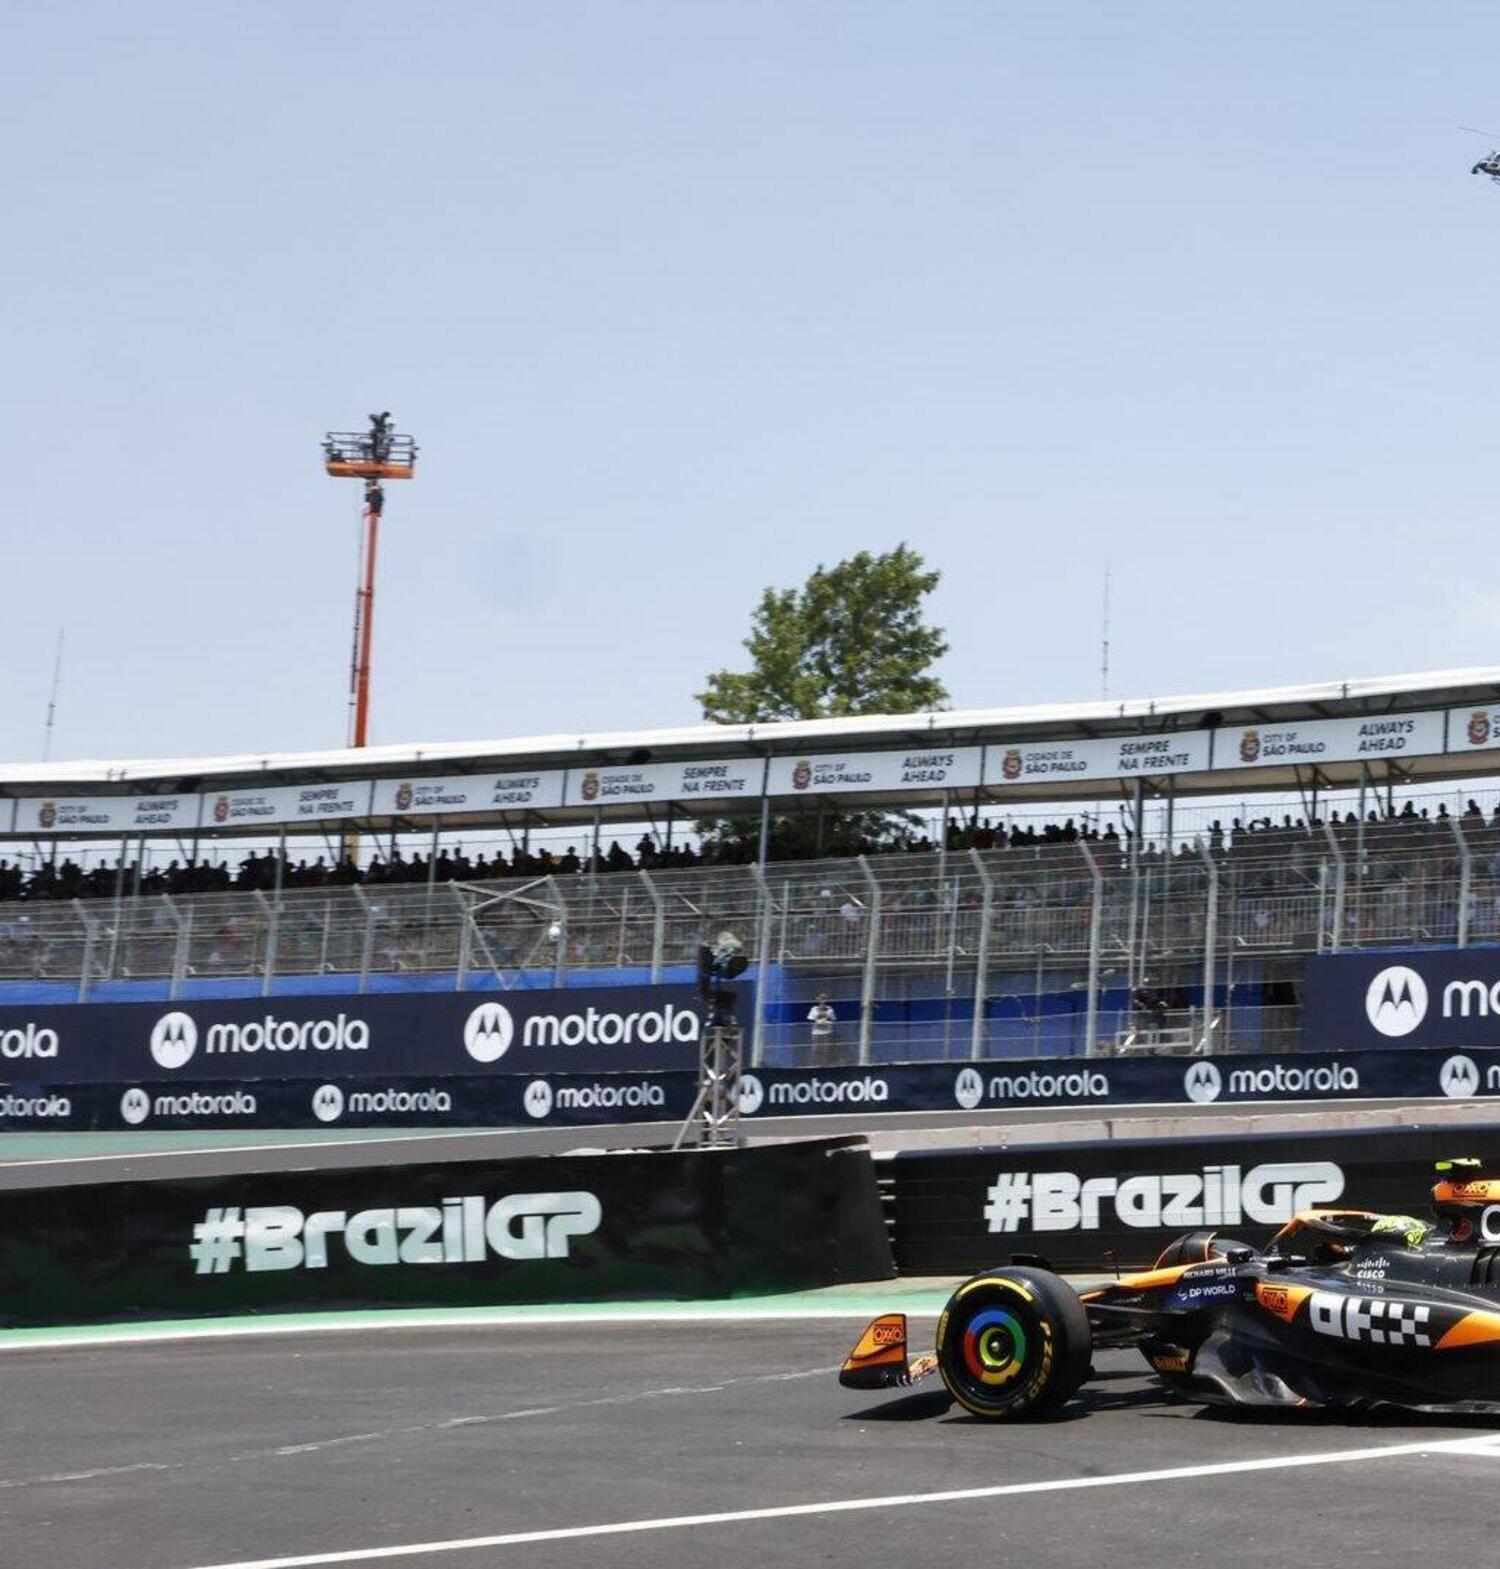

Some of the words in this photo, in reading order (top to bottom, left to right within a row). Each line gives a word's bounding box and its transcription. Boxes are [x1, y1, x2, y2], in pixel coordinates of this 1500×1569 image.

[1359, 720, 1414, 737] ALWAYS
[1264, 734, 1283, 743] CITY
[1286, 732, 1297, 742] OF
[1358, 737, 1406, 752] AHEAD
[1119, 740, 1170, 755] SEMPRE
[1289, 742, 1325, 754] PAULO
[902, 754, 953, 768] ALWAYS
[1051, 761, 1087, 772] PAULO
[1118, 758, 1138, 770] NA
[1143, 753, 1190, 768] FRENTE
[684, 766, 728, 779] SEMPRE
[837, 773, 871, 783] PAULO
[900, 770, 945, 782] AHEAD
[623, 783, 655, 794] PAULO
[683, 782, 699, 792] NA
[704, 779, 745, 791] FRENTE
[207, 1014, 368, 1053] motorola
[524, 1005, 698, 1046] motorola
[990, 1070, 1108, 1097] motorola
[1230, 1063, 1358, 1092] motorola
[557, 1082, 664, 1107] motorola
[770, 1077, 888, 1103] motorola
[155, 1092, 256, 1114] motorola
[349, 1089, 450, 1111] motorola
[984, 1162, 1345, 1233] #BrazilGP
[190, 1191, 602, 1276] #BrazilGP
[1189, 1288, 1201, 1298] DP
[1203, 1284, 1236, 1297] WORLD
